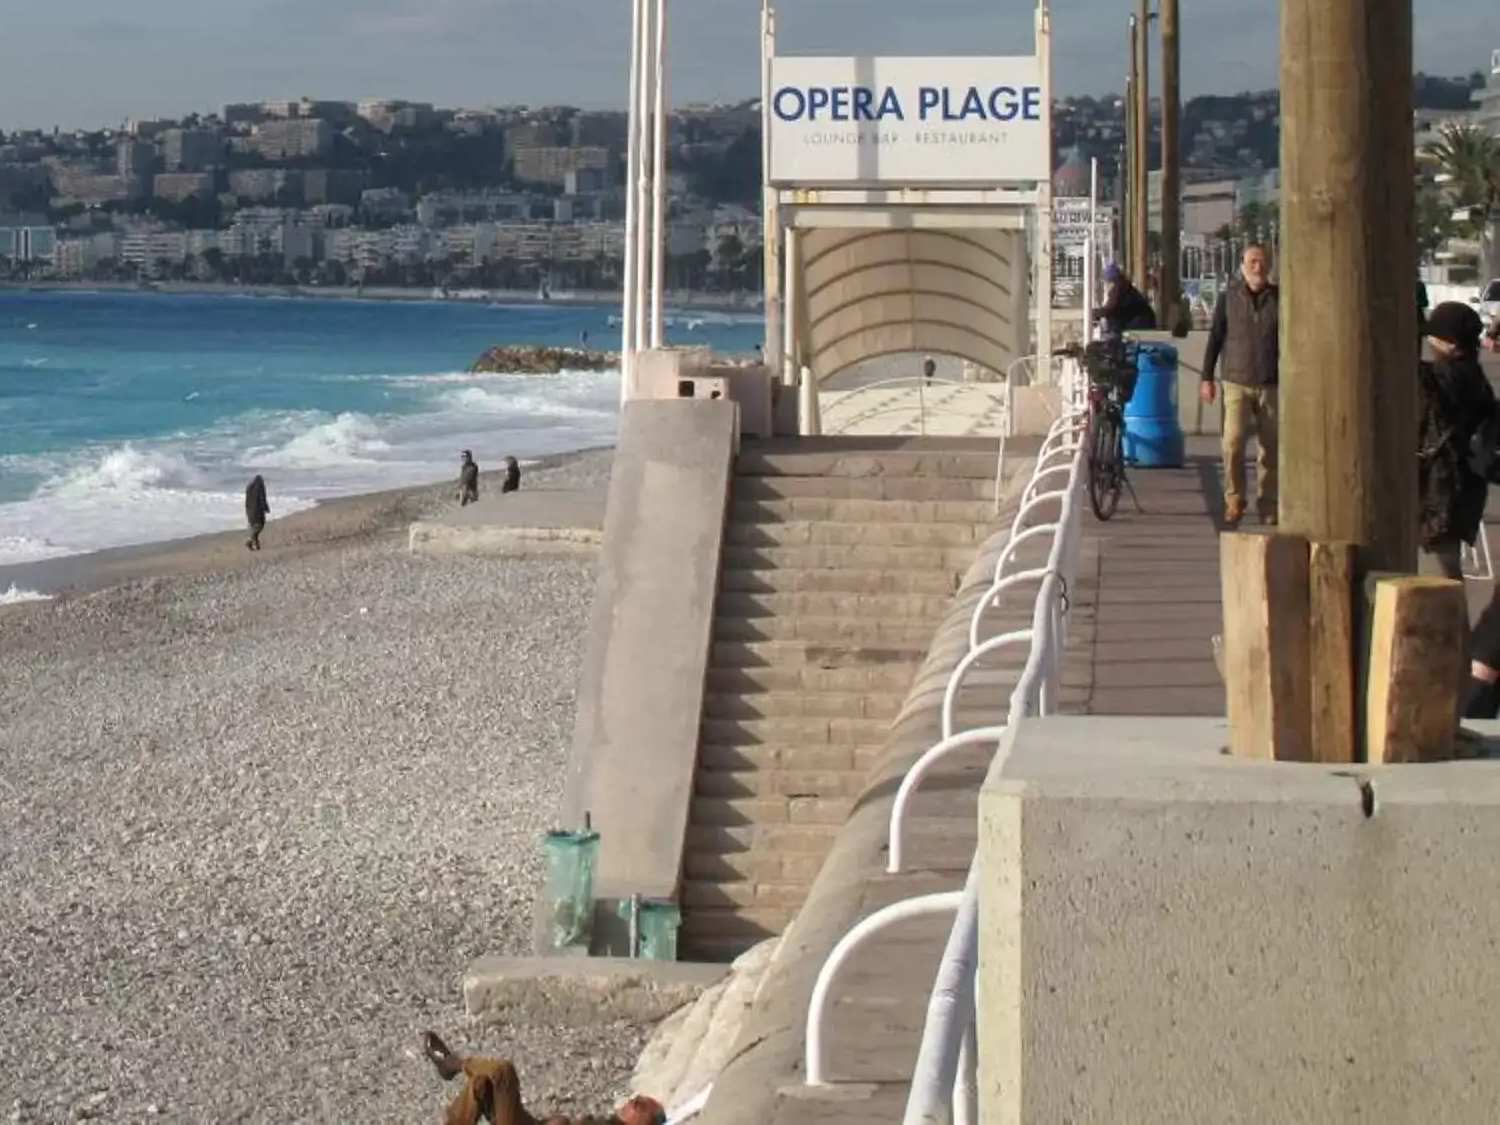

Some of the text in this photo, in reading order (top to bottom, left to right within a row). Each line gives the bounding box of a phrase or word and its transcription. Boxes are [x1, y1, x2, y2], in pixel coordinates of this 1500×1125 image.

[773, 86, 1041, 122] OPERA PLAGE
[803, 131, 1008, 145] LOUNGE BAR RESTAURANT
